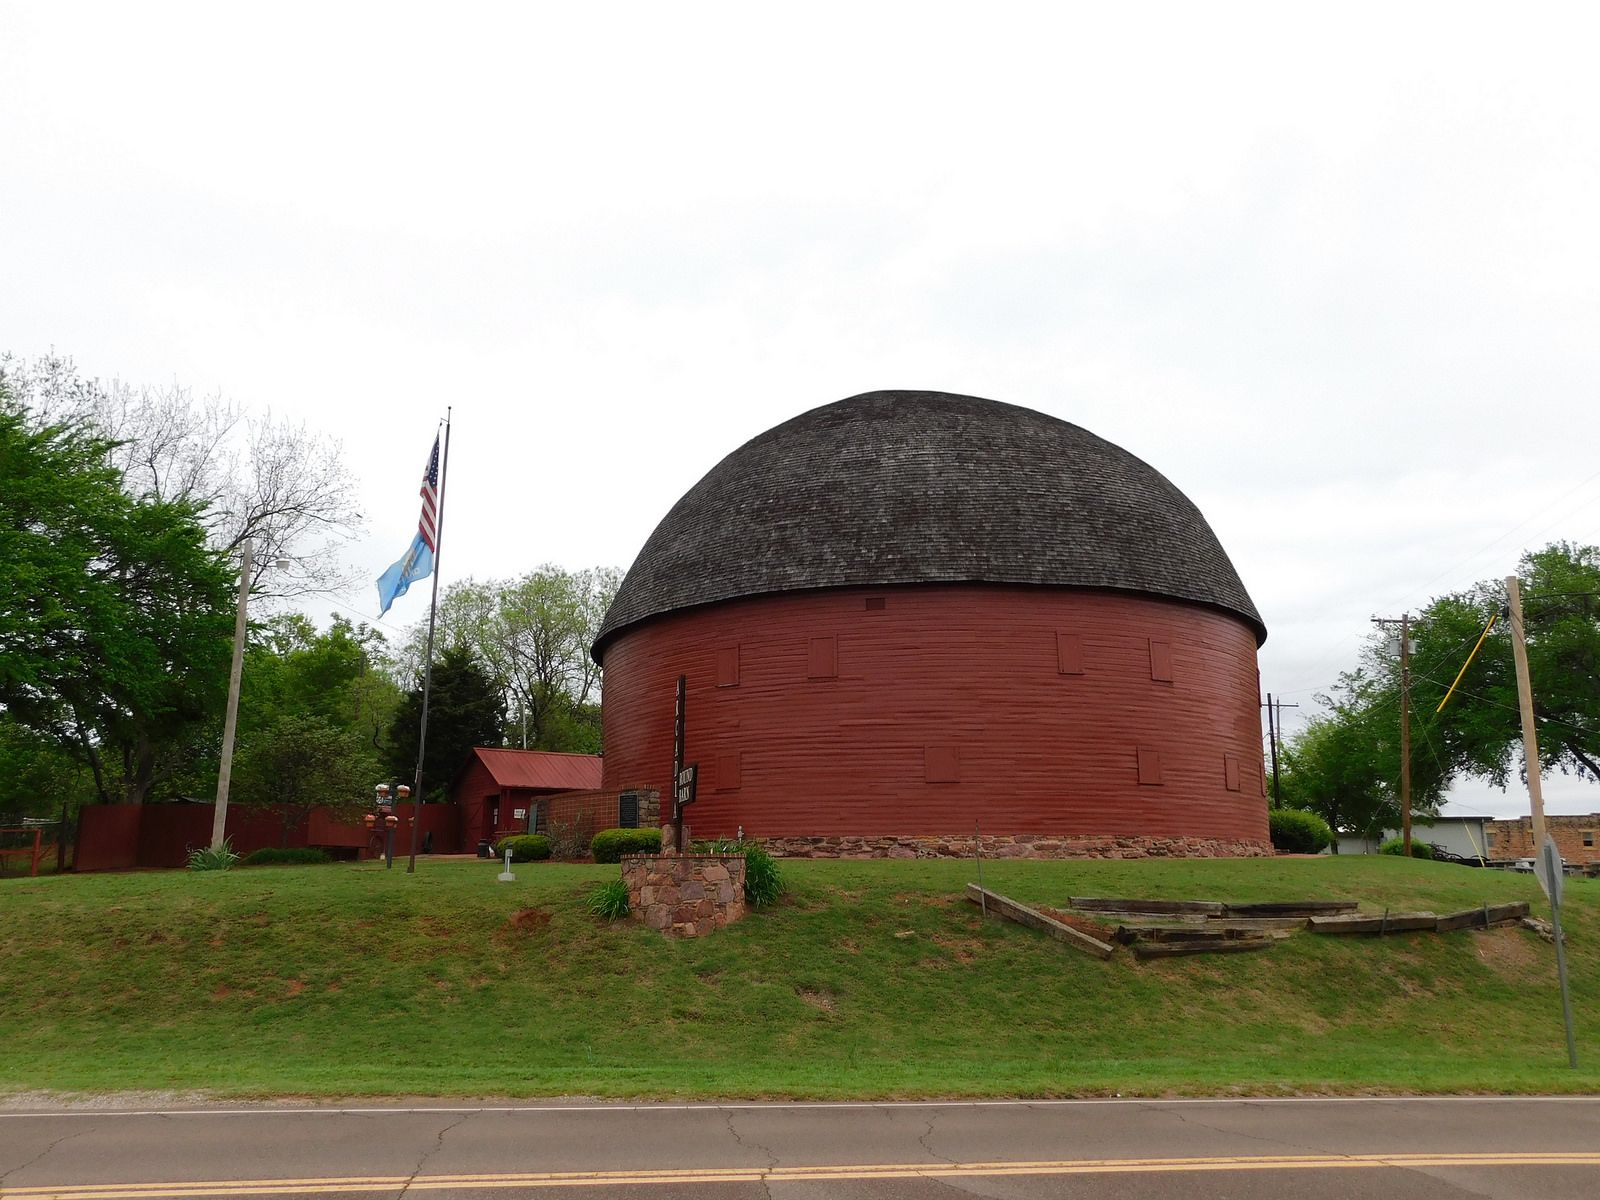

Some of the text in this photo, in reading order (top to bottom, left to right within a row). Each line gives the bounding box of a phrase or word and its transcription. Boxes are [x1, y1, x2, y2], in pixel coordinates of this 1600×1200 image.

[672, 680, 680, 819] ARCADIA
[680, 768, 693, 786] ROUND
[679, 786, 690, 804] BARN
